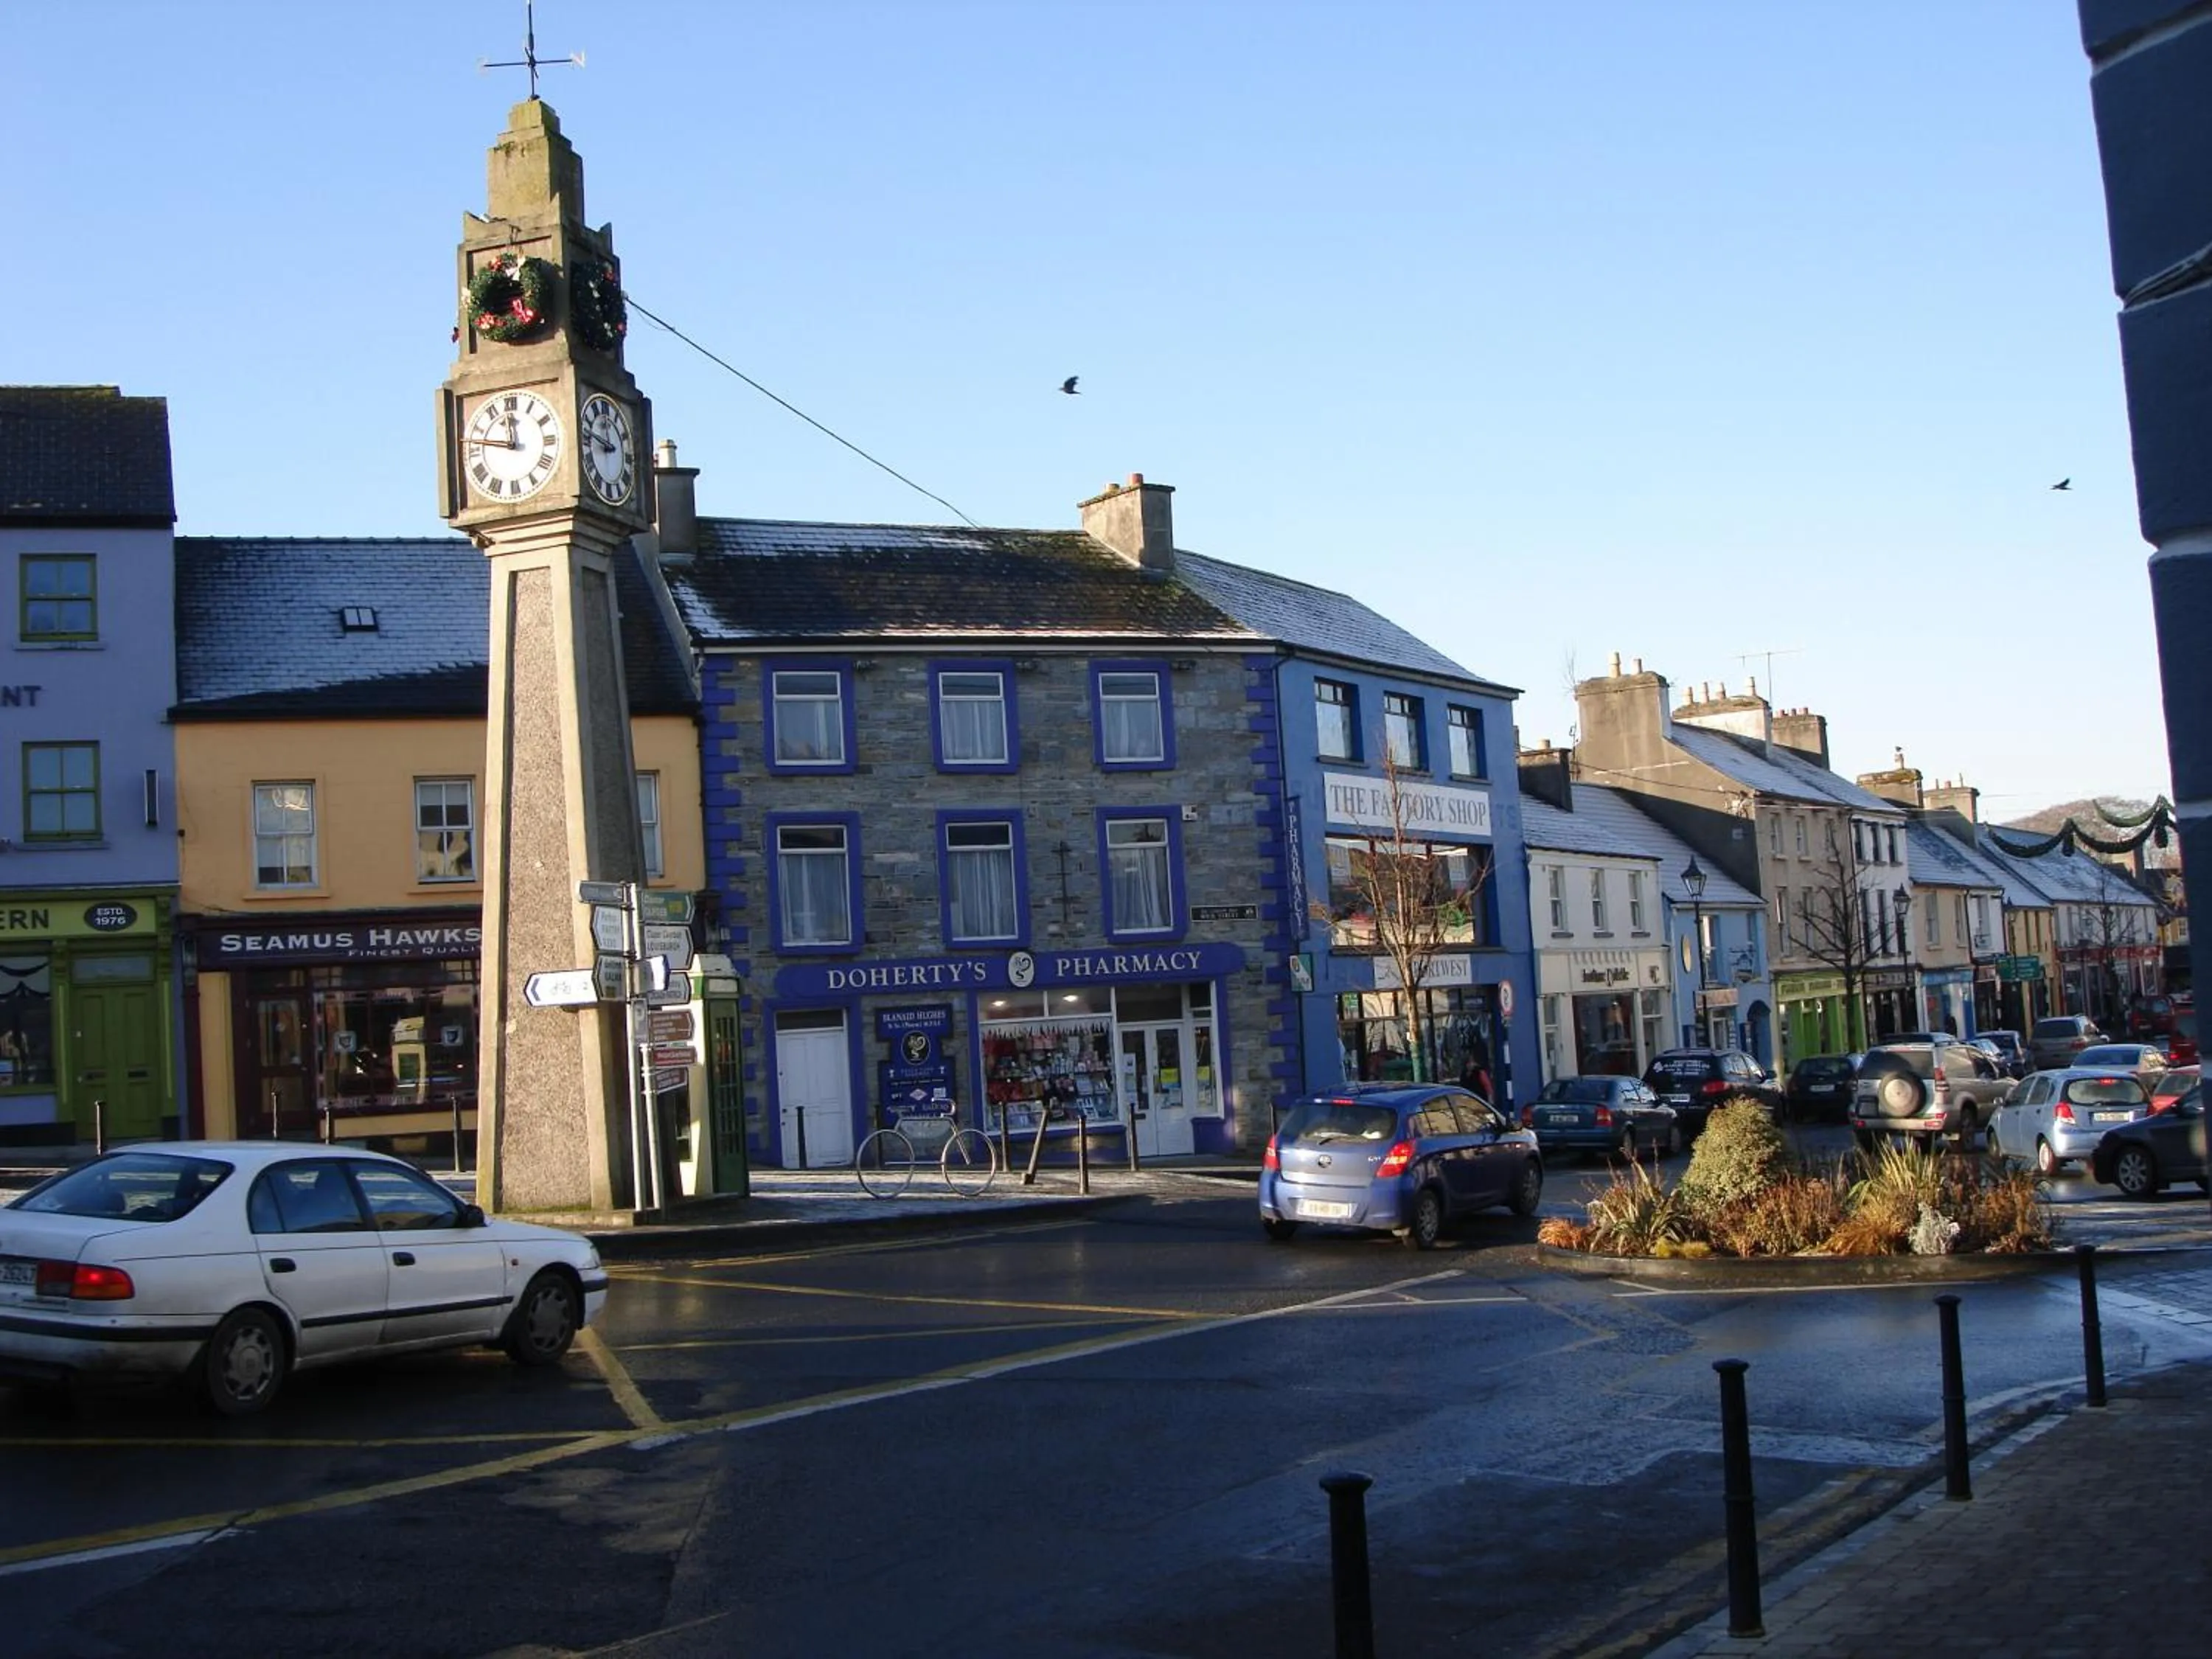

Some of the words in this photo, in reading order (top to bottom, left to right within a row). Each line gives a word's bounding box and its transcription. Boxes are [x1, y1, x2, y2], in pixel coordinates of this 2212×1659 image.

[2, 685, 42, 707] NT
[1329, 784, 1368, 815] THE
[1371, 789, 1447, 822] FATORY
[1447, 799, 1486, 827] SHOP
[1288, 815, 1304, 928] PHARMACY
[94, 917, 127, 925] 1976
[96, 908, 126, 917] ESTD.
[221, 933, 354, 952] SEAMUS
[369, 928, 481, 946] HAWKS
[348, 948, 411, 957] FINEST
[827, 961, 987, 990] DOHERTY'S
[1057, 950, 1203, 977] PHARMACY
